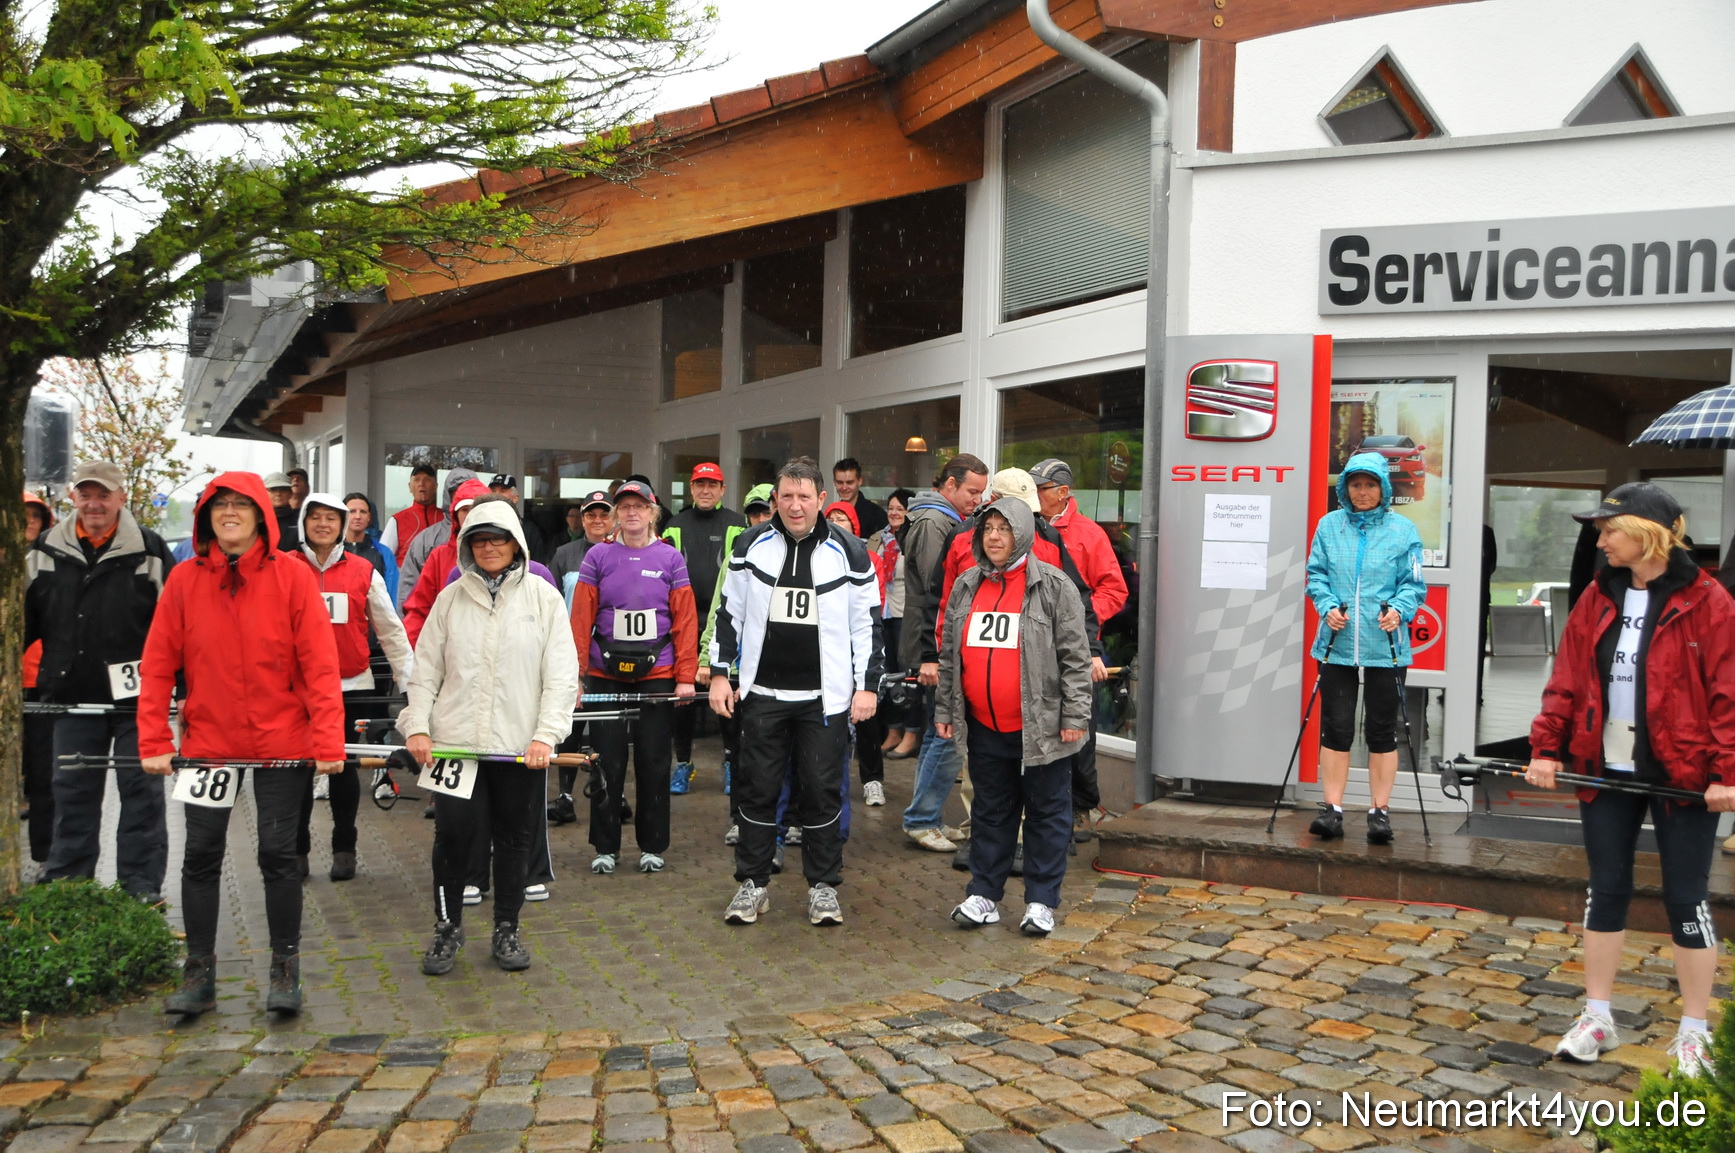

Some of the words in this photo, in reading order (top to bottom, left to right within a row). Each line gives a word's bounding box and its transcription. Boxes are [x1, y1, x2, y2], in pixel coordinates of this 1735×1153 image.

[1171, 465, 1295, 482] SEAT
[1215, 503, 1246, 511] Ausgabe
[1395, 496, 1415, 504] IBIZA
[1212, 512, 1262, 520] Startnummern
[784, 590, 810, 619] 19
[624, 612, 646, 637] 10
[979, 613, 1010, 642] 20
[121, 663, 141, 691] 3
[619, 662, 635, 672] CAT
[1616, 674, 1633, 682] and
[190, 767, 231, 801] 38
[430, 758, 464, 789] 43
